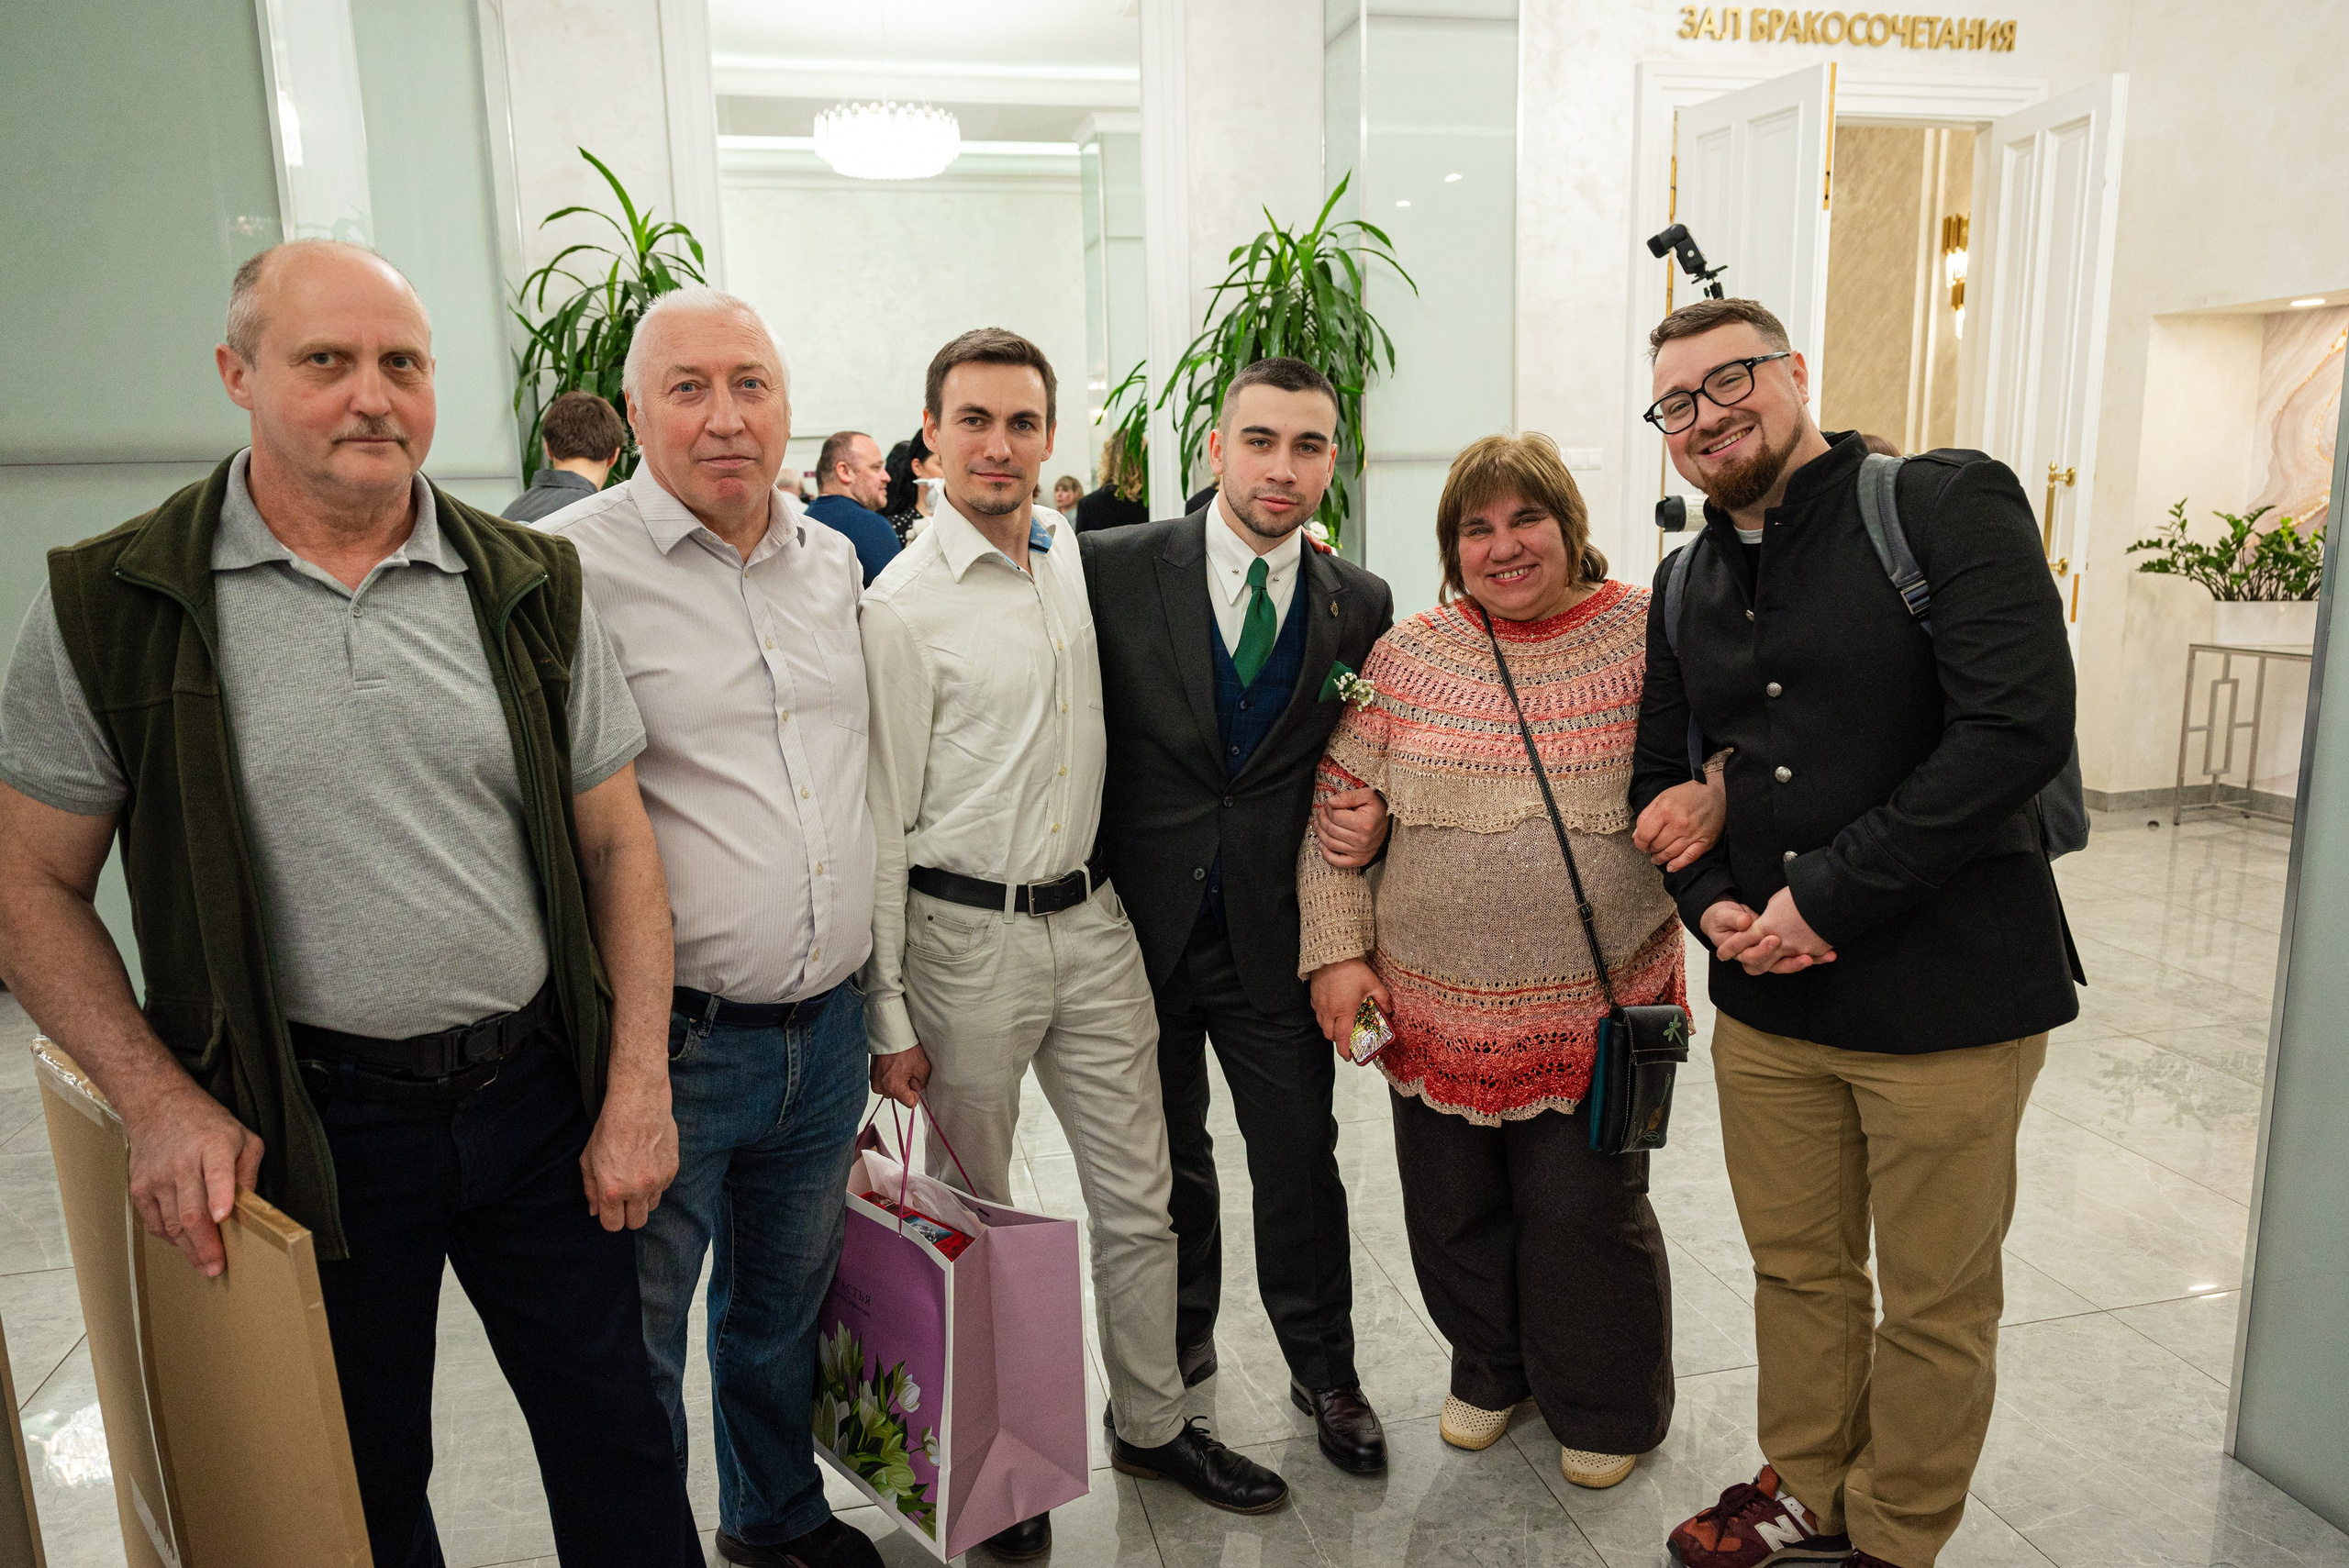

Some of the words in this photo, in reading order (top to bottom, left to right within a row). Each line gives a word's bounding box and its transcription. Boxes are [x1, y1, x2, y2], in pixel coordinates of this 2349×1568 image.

[1677, 4, 1742, 41] ЗАЛ
[1749, 8, 2018, 52] БРАКОСОЧЕТАНИЯ
[1753, 1514, 1805, 1552] N
